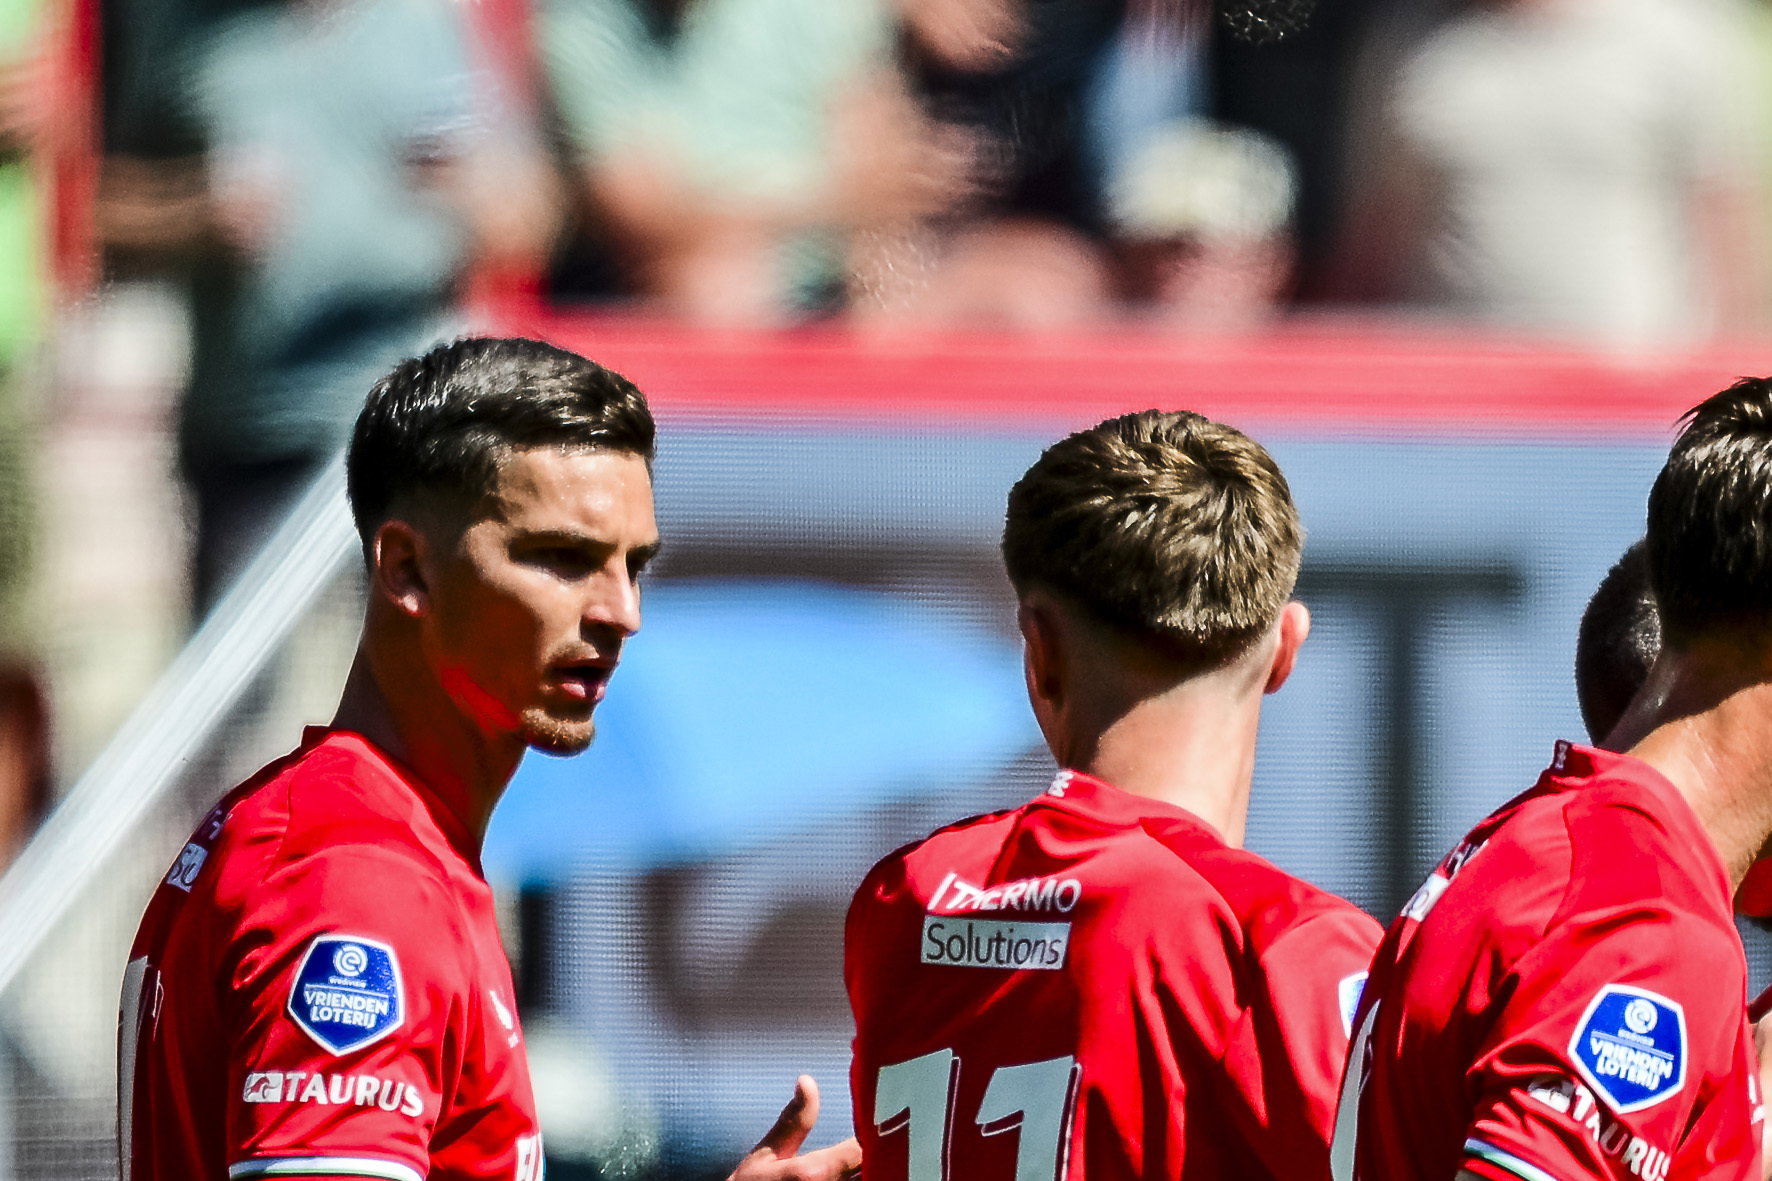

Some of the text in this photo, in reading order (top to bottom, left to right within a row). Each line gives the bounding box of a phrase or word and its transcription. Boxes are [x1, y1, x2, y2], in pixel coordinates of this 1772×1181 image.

[926, 922, 1062, 966] Solutions
[304, 990, 389, 1016] VRIENDEN
[310, 1005, 378, 1029] LOTERIJ
[1590, 1036, 1673, 1080] VRIENDEN
[1595, 1058, 1661, 1091] LOTERIJ
[285, 1072, 424, 1118] TAURUS
